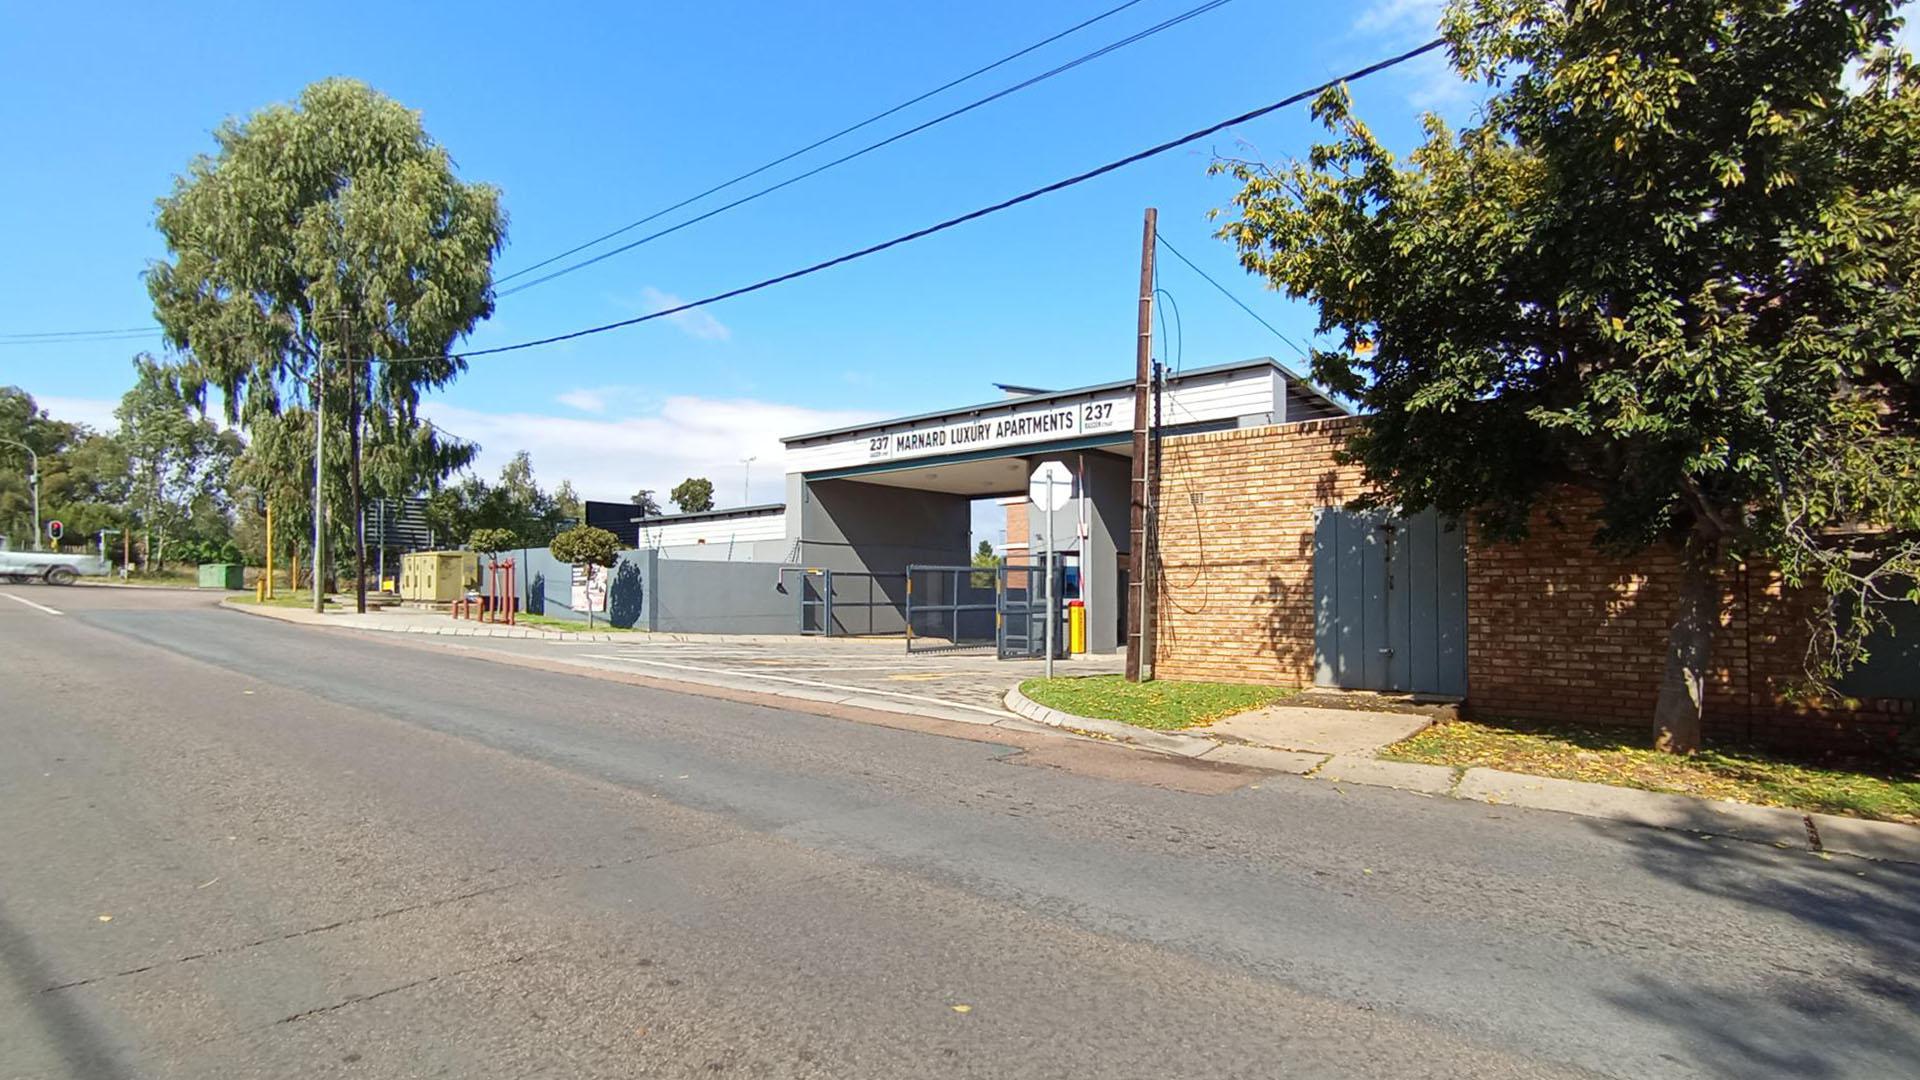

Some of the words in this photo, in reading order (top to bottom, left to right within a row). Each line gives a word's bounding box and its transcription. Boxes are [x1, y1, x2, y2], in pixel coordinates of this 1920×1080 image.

[1085, 403, 1112, 421] 237
[896, 430, 946, 452] MARNARD
[951, 423, 991, 444] LUXURY
[996, 411, 1073, 439] APARTMENTS
[870, 437, 889, 451] 237
